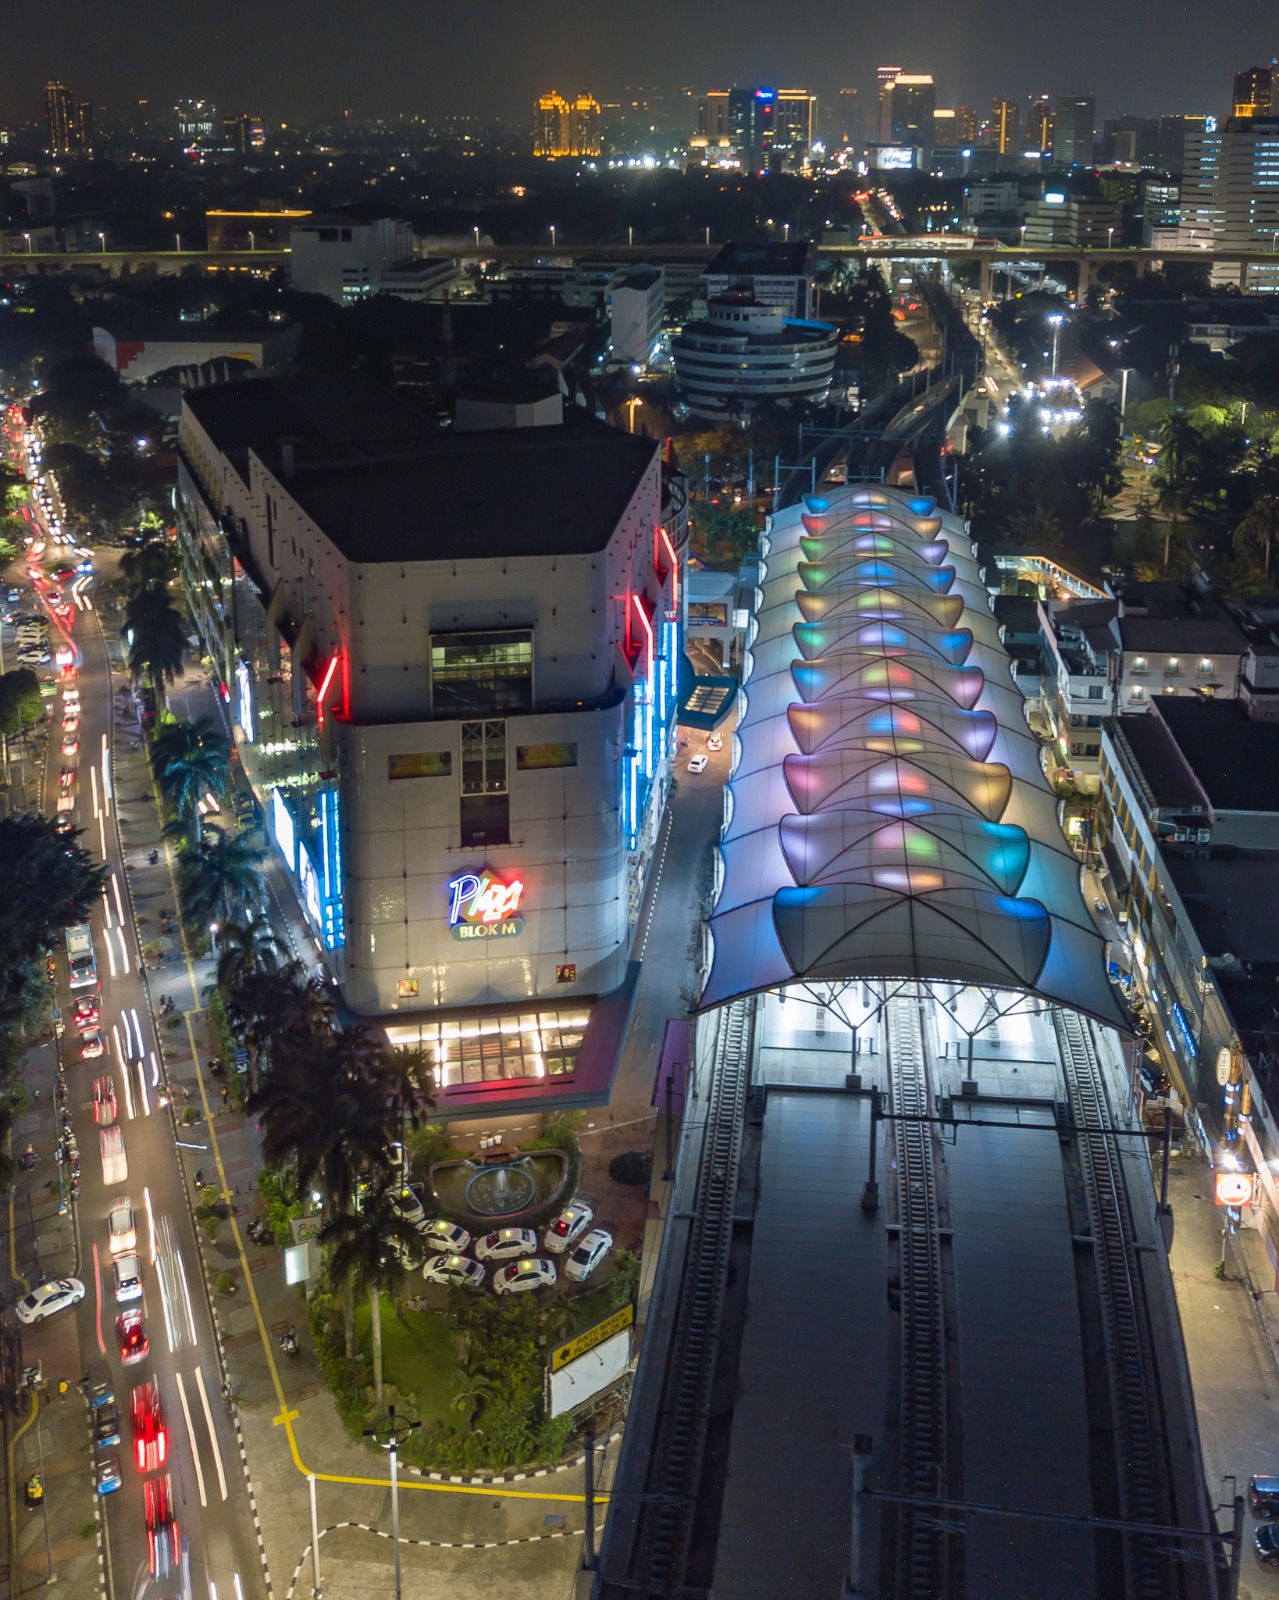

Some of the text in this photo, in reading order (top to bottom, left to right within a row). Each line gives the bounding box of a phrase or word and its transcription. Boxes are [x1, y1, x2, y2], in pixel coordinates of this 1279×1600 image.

[450, 874, 523, 923] Plaza
[459, 922, 516, 938] BLOK M
[574, 1336, 598, 1355] PLAZA
[601, 1324, 620, 1340] BLOK
[577, 1312, 626, 1346] PINTU MASUK
